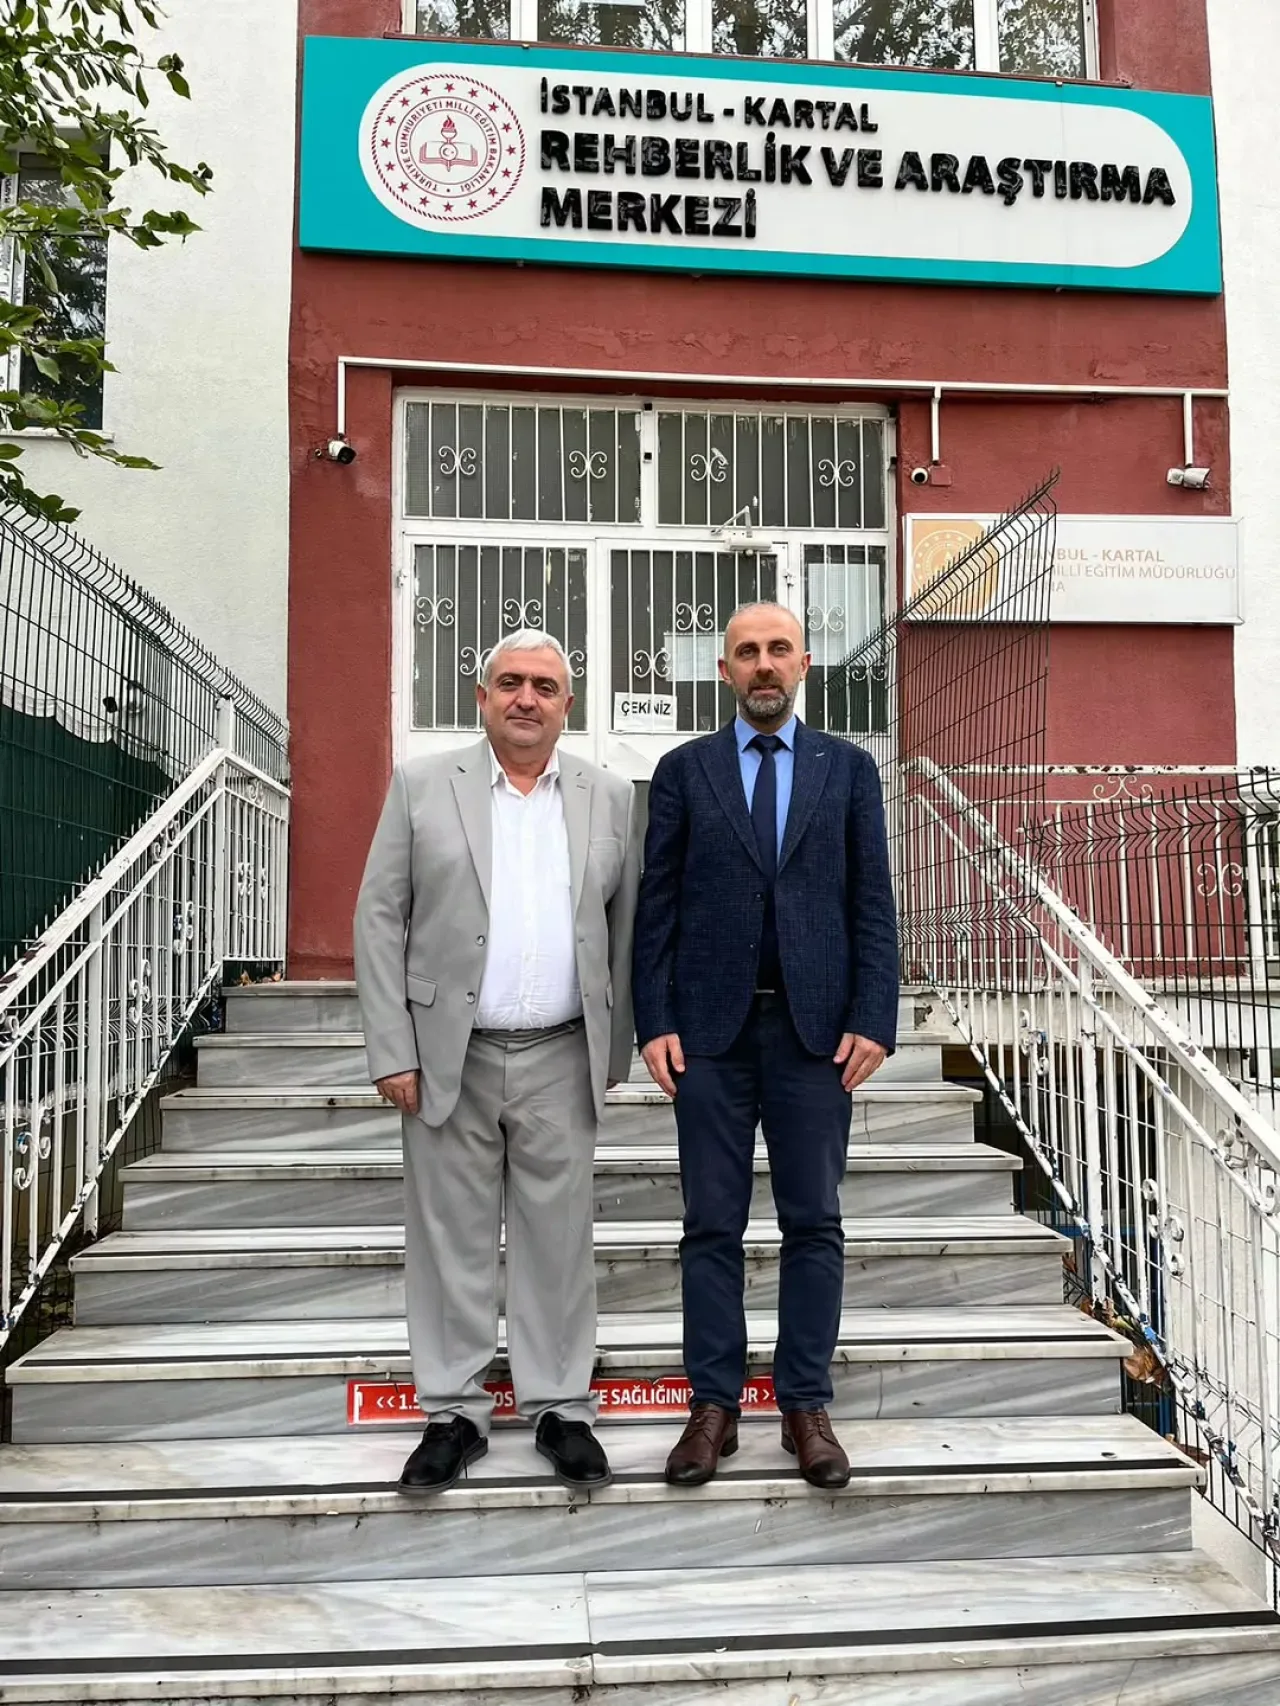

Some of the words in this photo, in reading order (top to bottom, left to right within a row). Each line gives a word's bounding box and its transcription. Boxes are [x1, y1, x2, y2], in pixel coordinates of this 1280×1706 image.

[540, 76, 714, 124] İSTANBUL
[743, 95, 878, 132] KARTAL
[460, 148, 497, 192] BAKANLIĞI
[540, 130, 812, 186] REHBERLİK
[820, 147, 883, 188] VE
[895, 151, 1176, 207] ARAŞTIRMA
[540, 187, 757, 239] MERKEZİ
[1085, 564, 1135, 578] EĞİTİM
[1139, 564, 1236, 579] MÜDÜRLÜĞÜ
[1102, 549, 1165, 562] KARTAL
